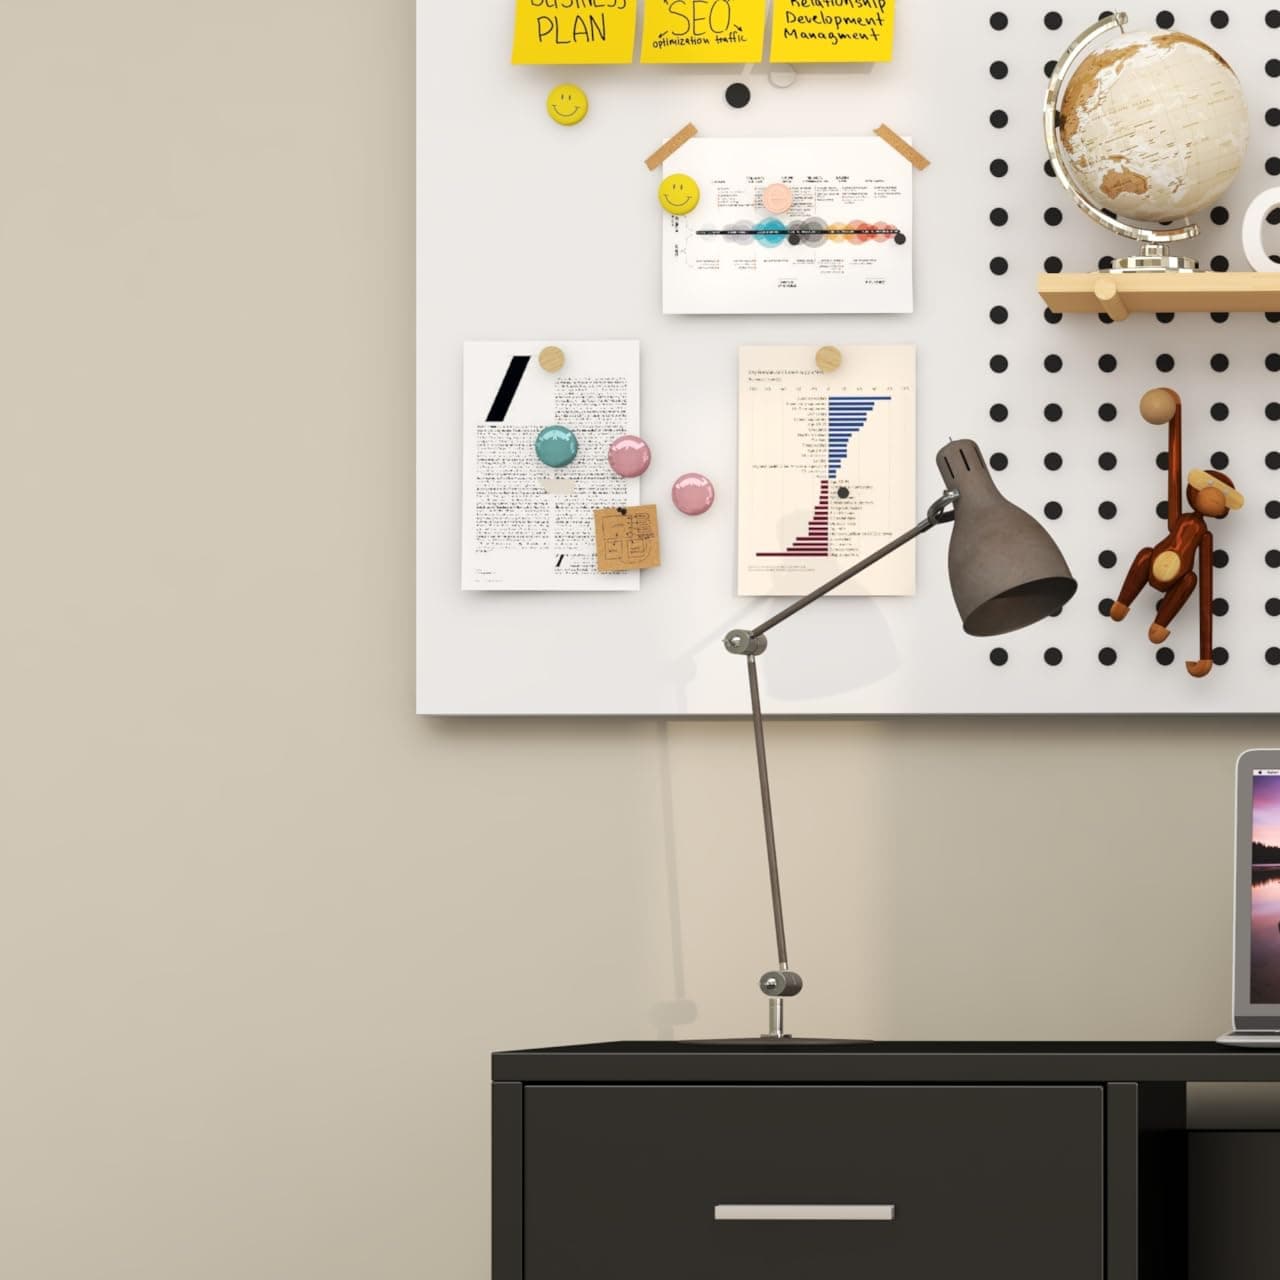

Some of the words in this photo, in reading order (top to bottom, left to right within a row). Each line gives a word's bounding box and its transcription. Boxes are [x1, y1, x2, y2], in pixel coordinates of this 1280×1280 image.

[537, 13, 606, 44] PLAN
[669, 0, 731, 36] SEO
[785, 11, 886, 30] Development
[784, 28, 880, 45] Managment
